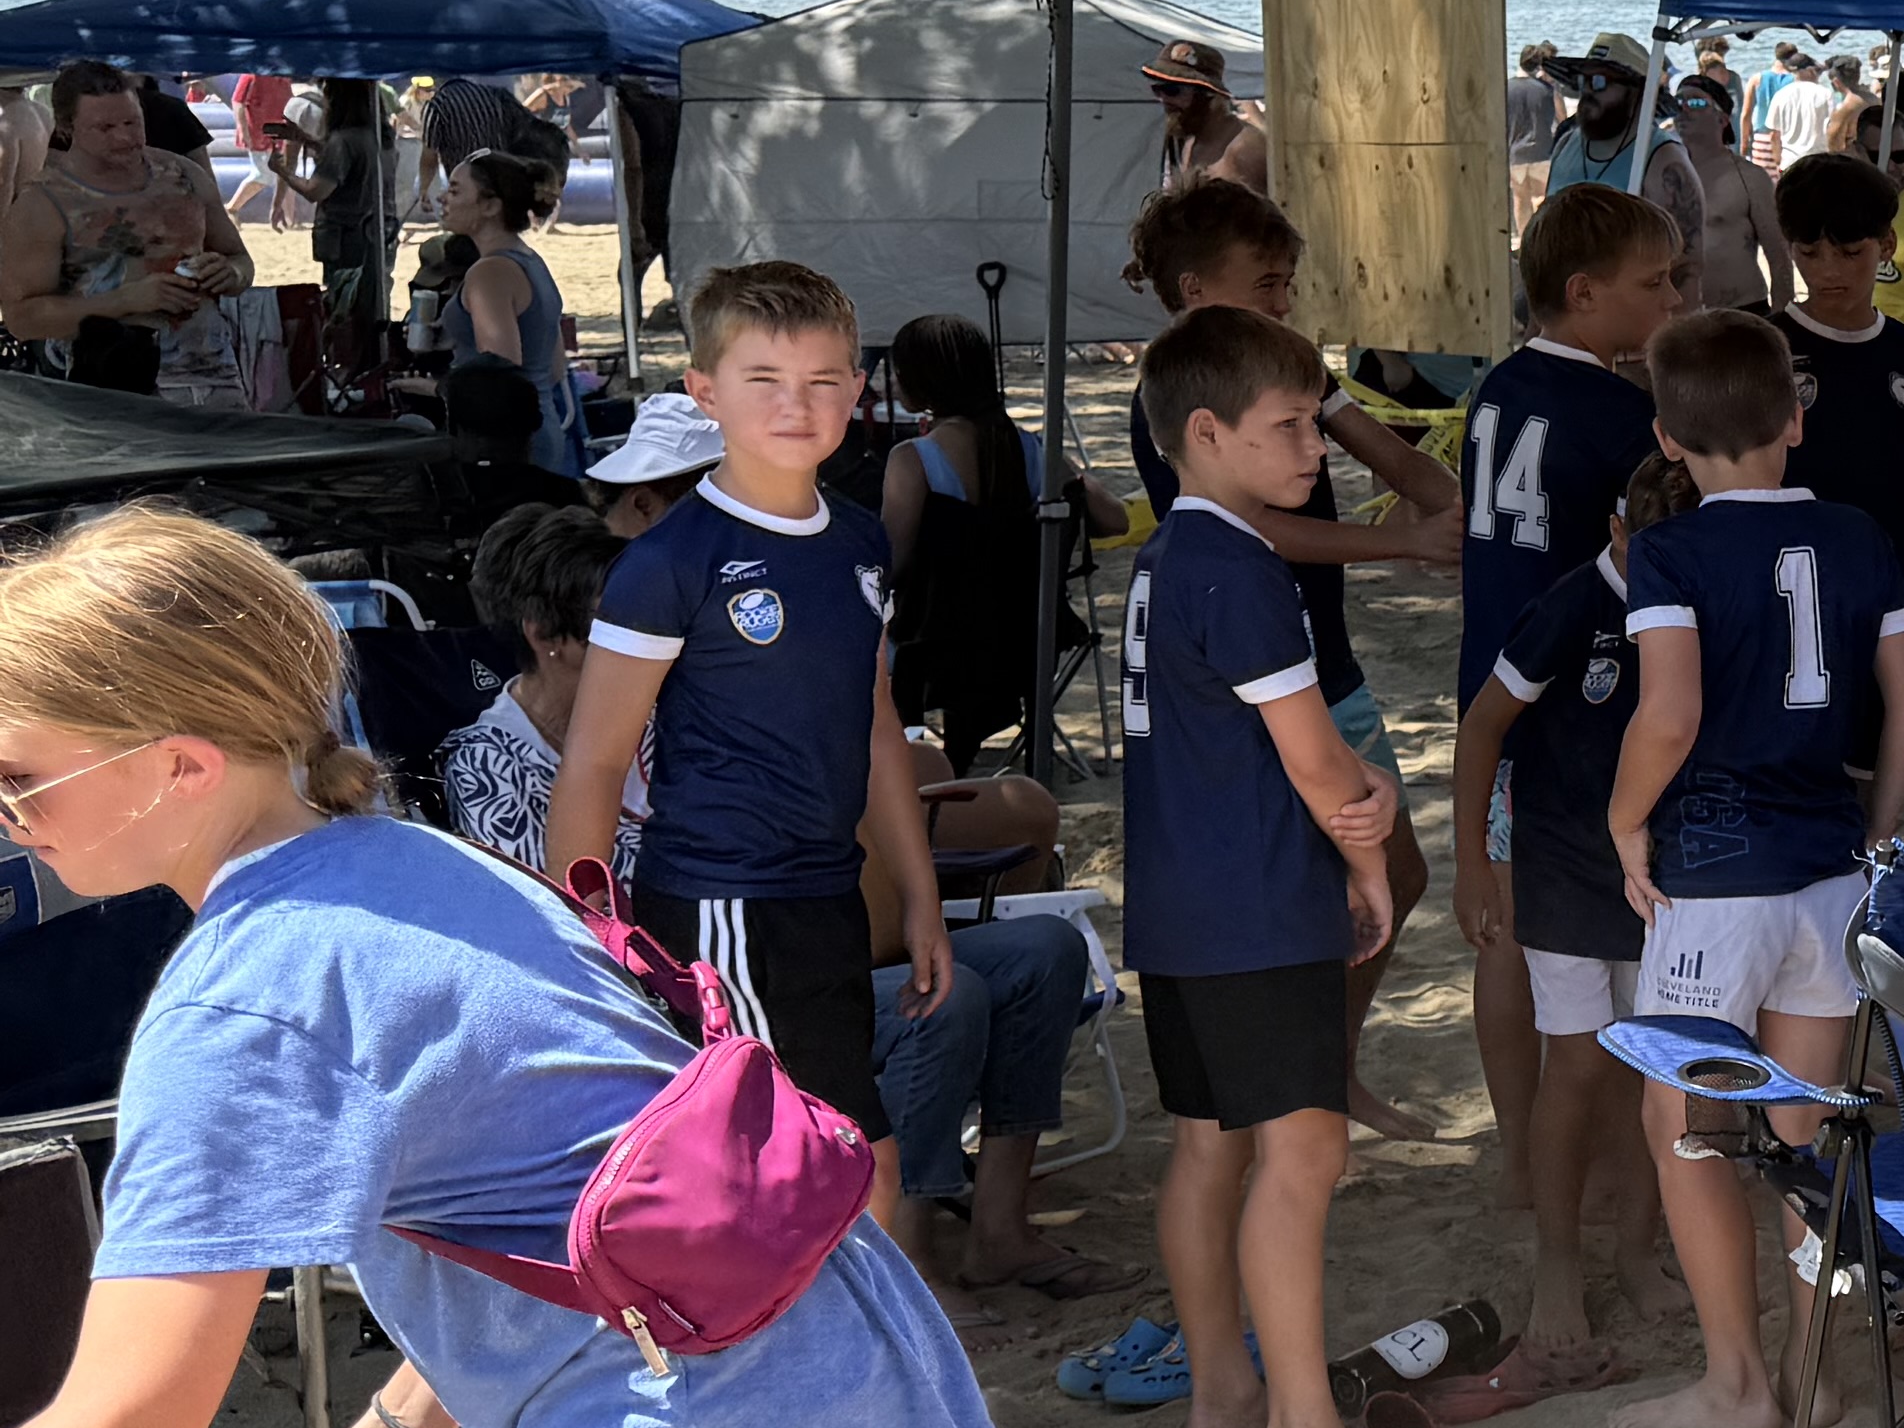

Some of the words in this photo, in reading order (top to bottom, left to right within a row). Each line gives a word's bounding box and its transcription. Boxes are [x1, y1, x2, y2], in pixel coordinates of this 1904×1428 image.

[1467, 403, 1550, 551] 14
[1774, 546, 1831, 709] 1
[1685, 995, 1720, 1009] TITLE
